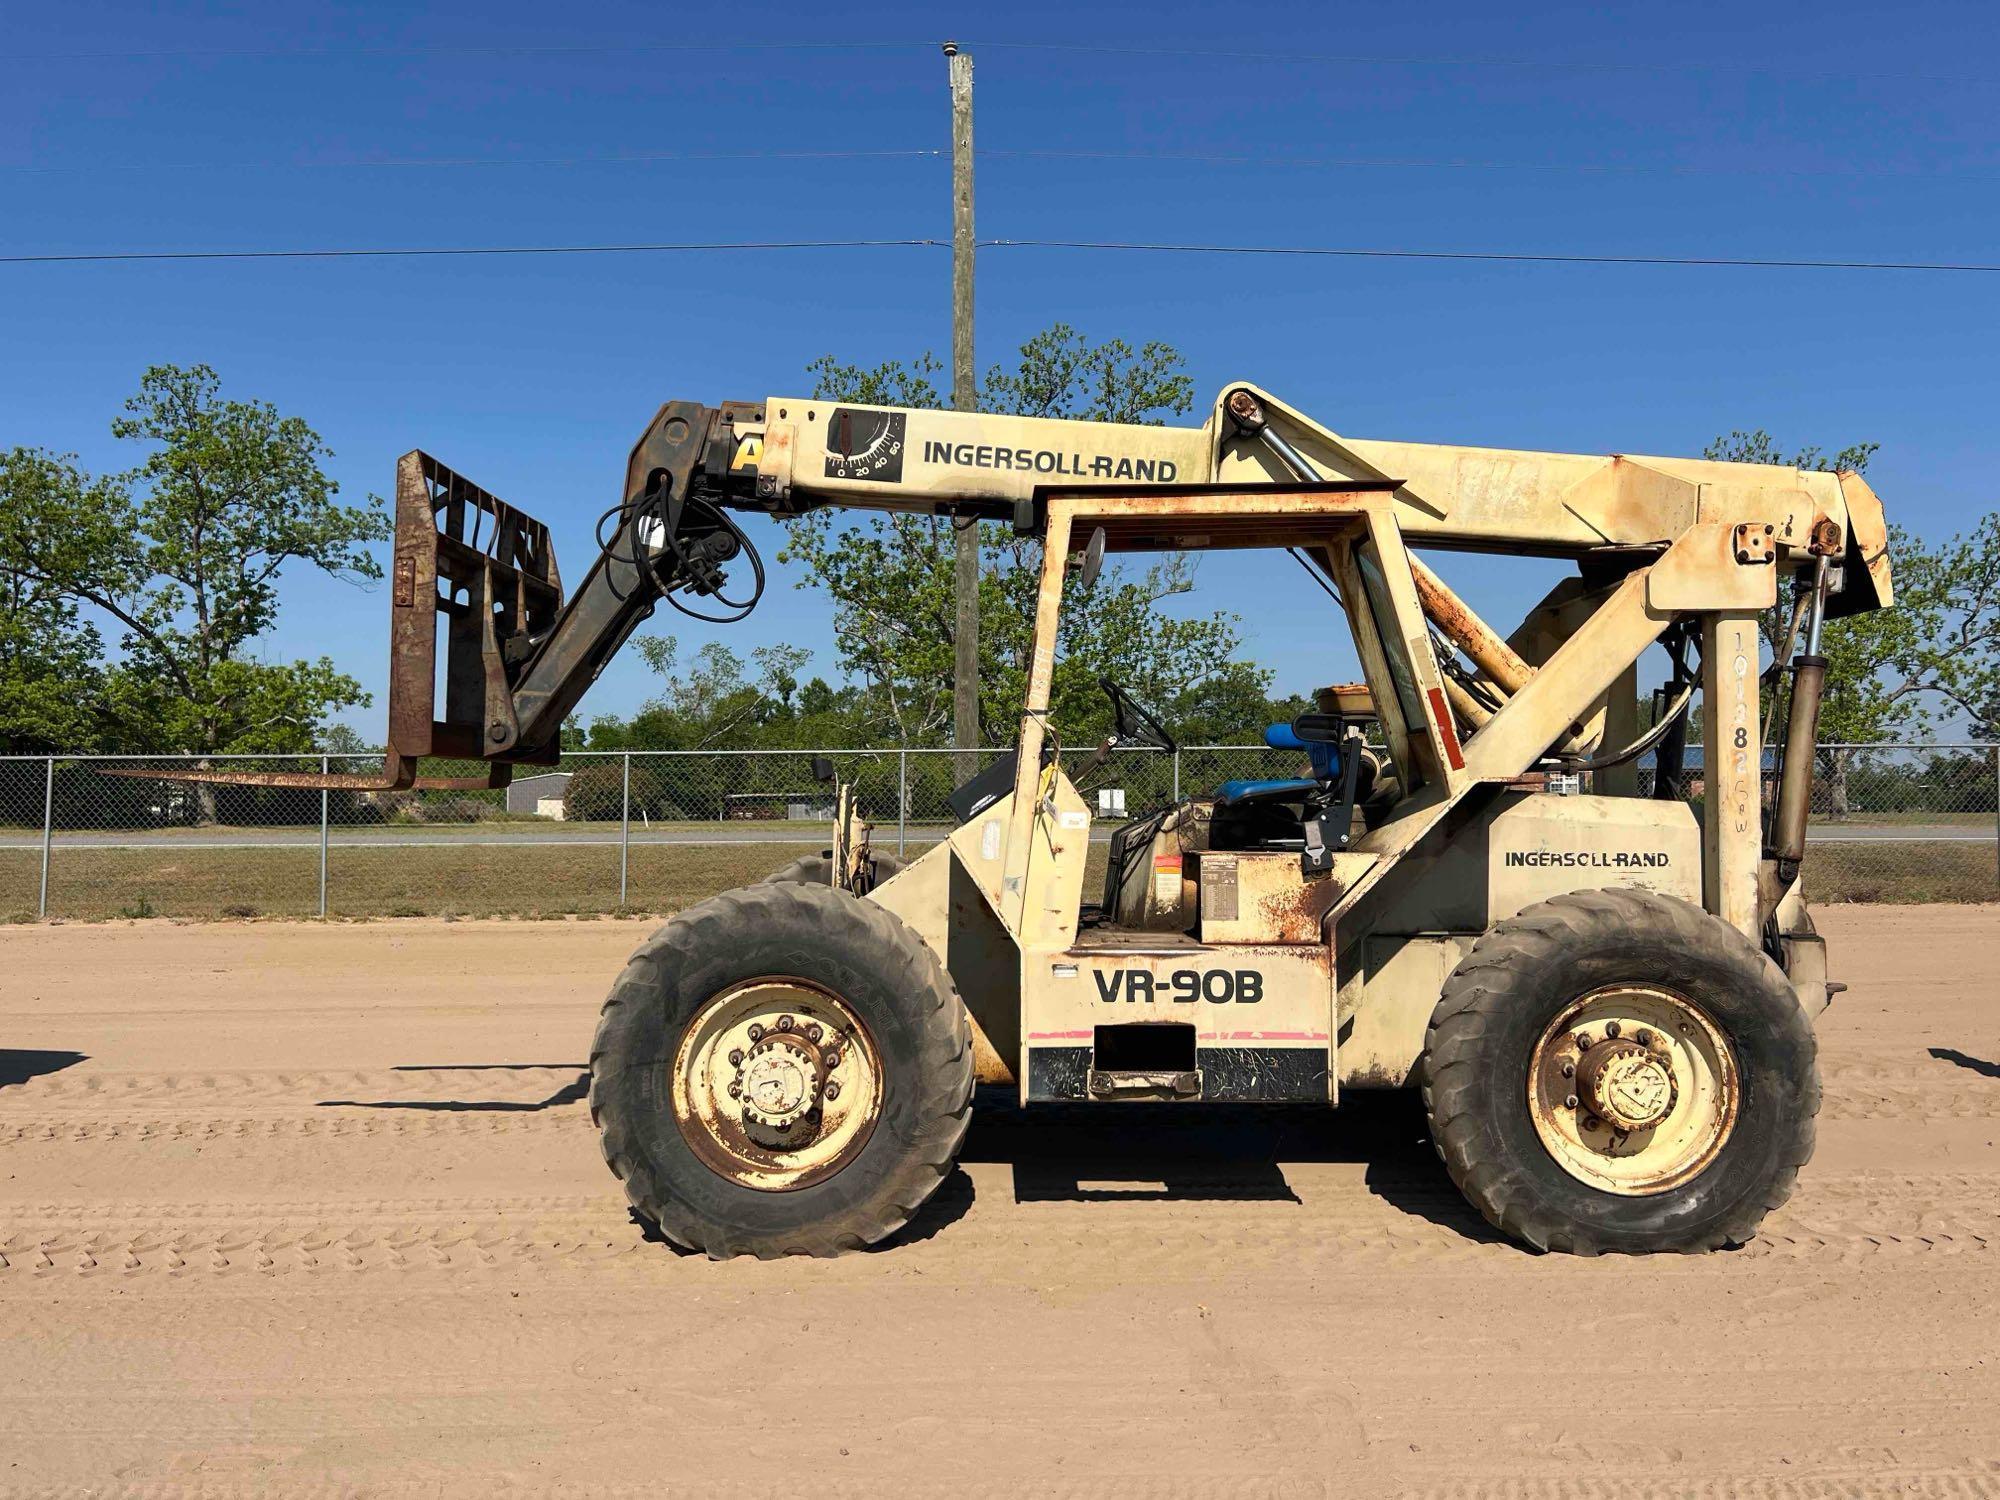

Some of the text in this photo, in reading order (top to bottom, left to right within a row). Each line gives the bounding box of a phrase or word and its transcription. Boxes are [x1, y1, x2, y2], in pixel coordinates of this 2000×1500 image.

[889, 441, 901, 456] 60
[874, 456, 888, 470] 40
[923, 440, 1179, 483] INGERSOLL-RAND
[837, 469, 846, 478] 0
[855, 466, 870, 477] 20
[1092, 969, 1264, 1004] VR-90B
